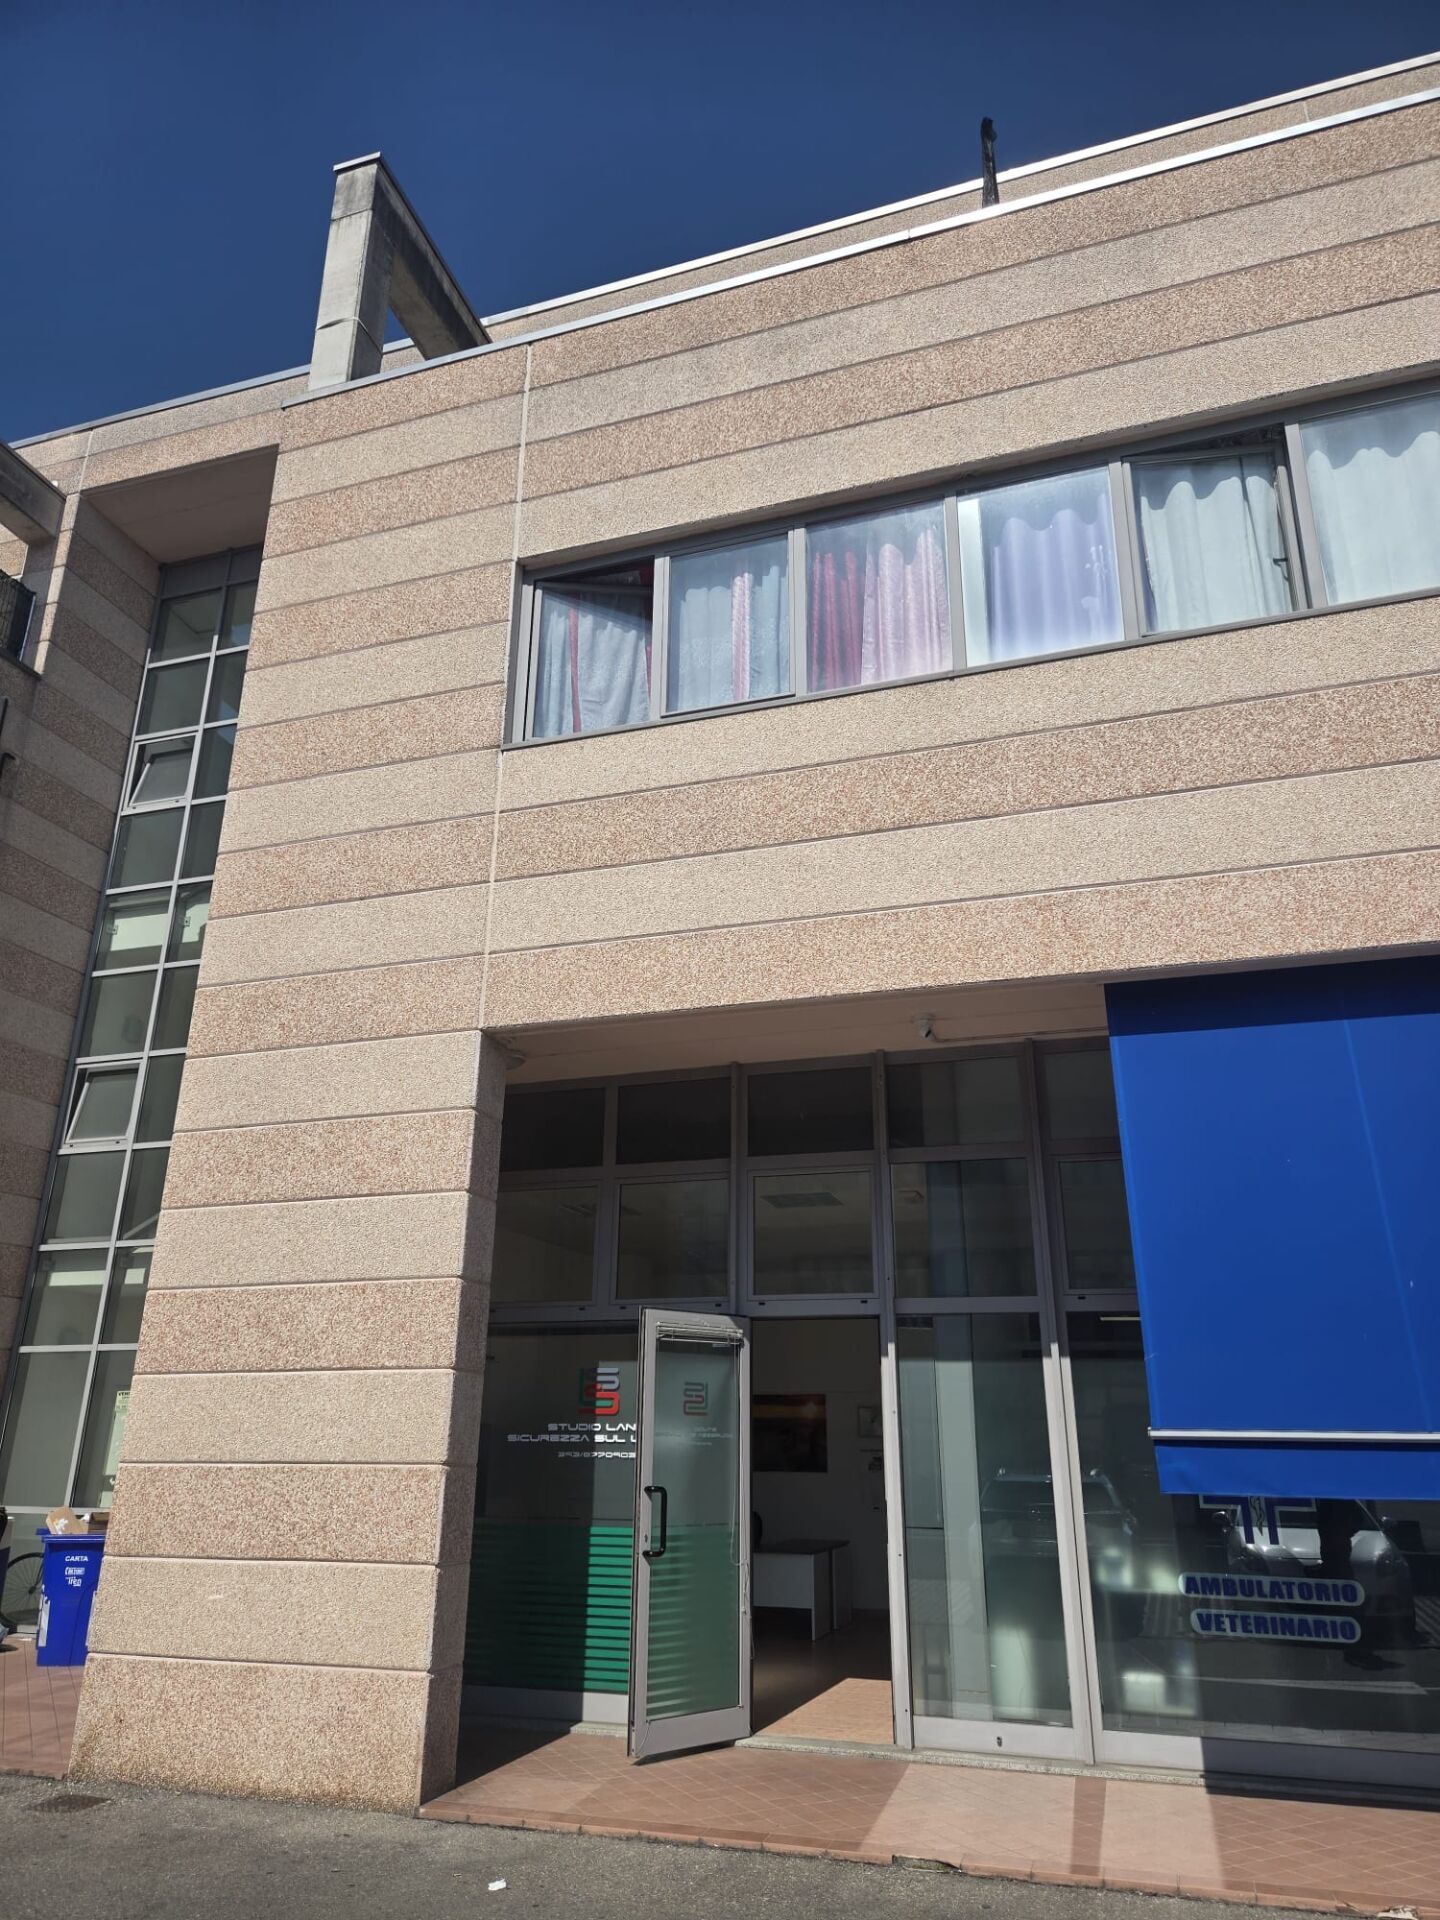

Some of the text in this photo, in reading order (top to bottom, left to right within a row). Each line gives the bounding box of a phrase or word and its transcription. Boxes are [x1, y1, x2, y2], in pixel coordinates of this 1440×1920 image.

[547, 1423, 602, 1432] STUDIO
[507, 1434, 590, 1443] SICUREZZA
[594, 1434, 626, 1443] SUL
[1184, 1576, 1358, 1603] AMBULATORIO
[1197, 1613, 1356, 1640] VETERINARIO
